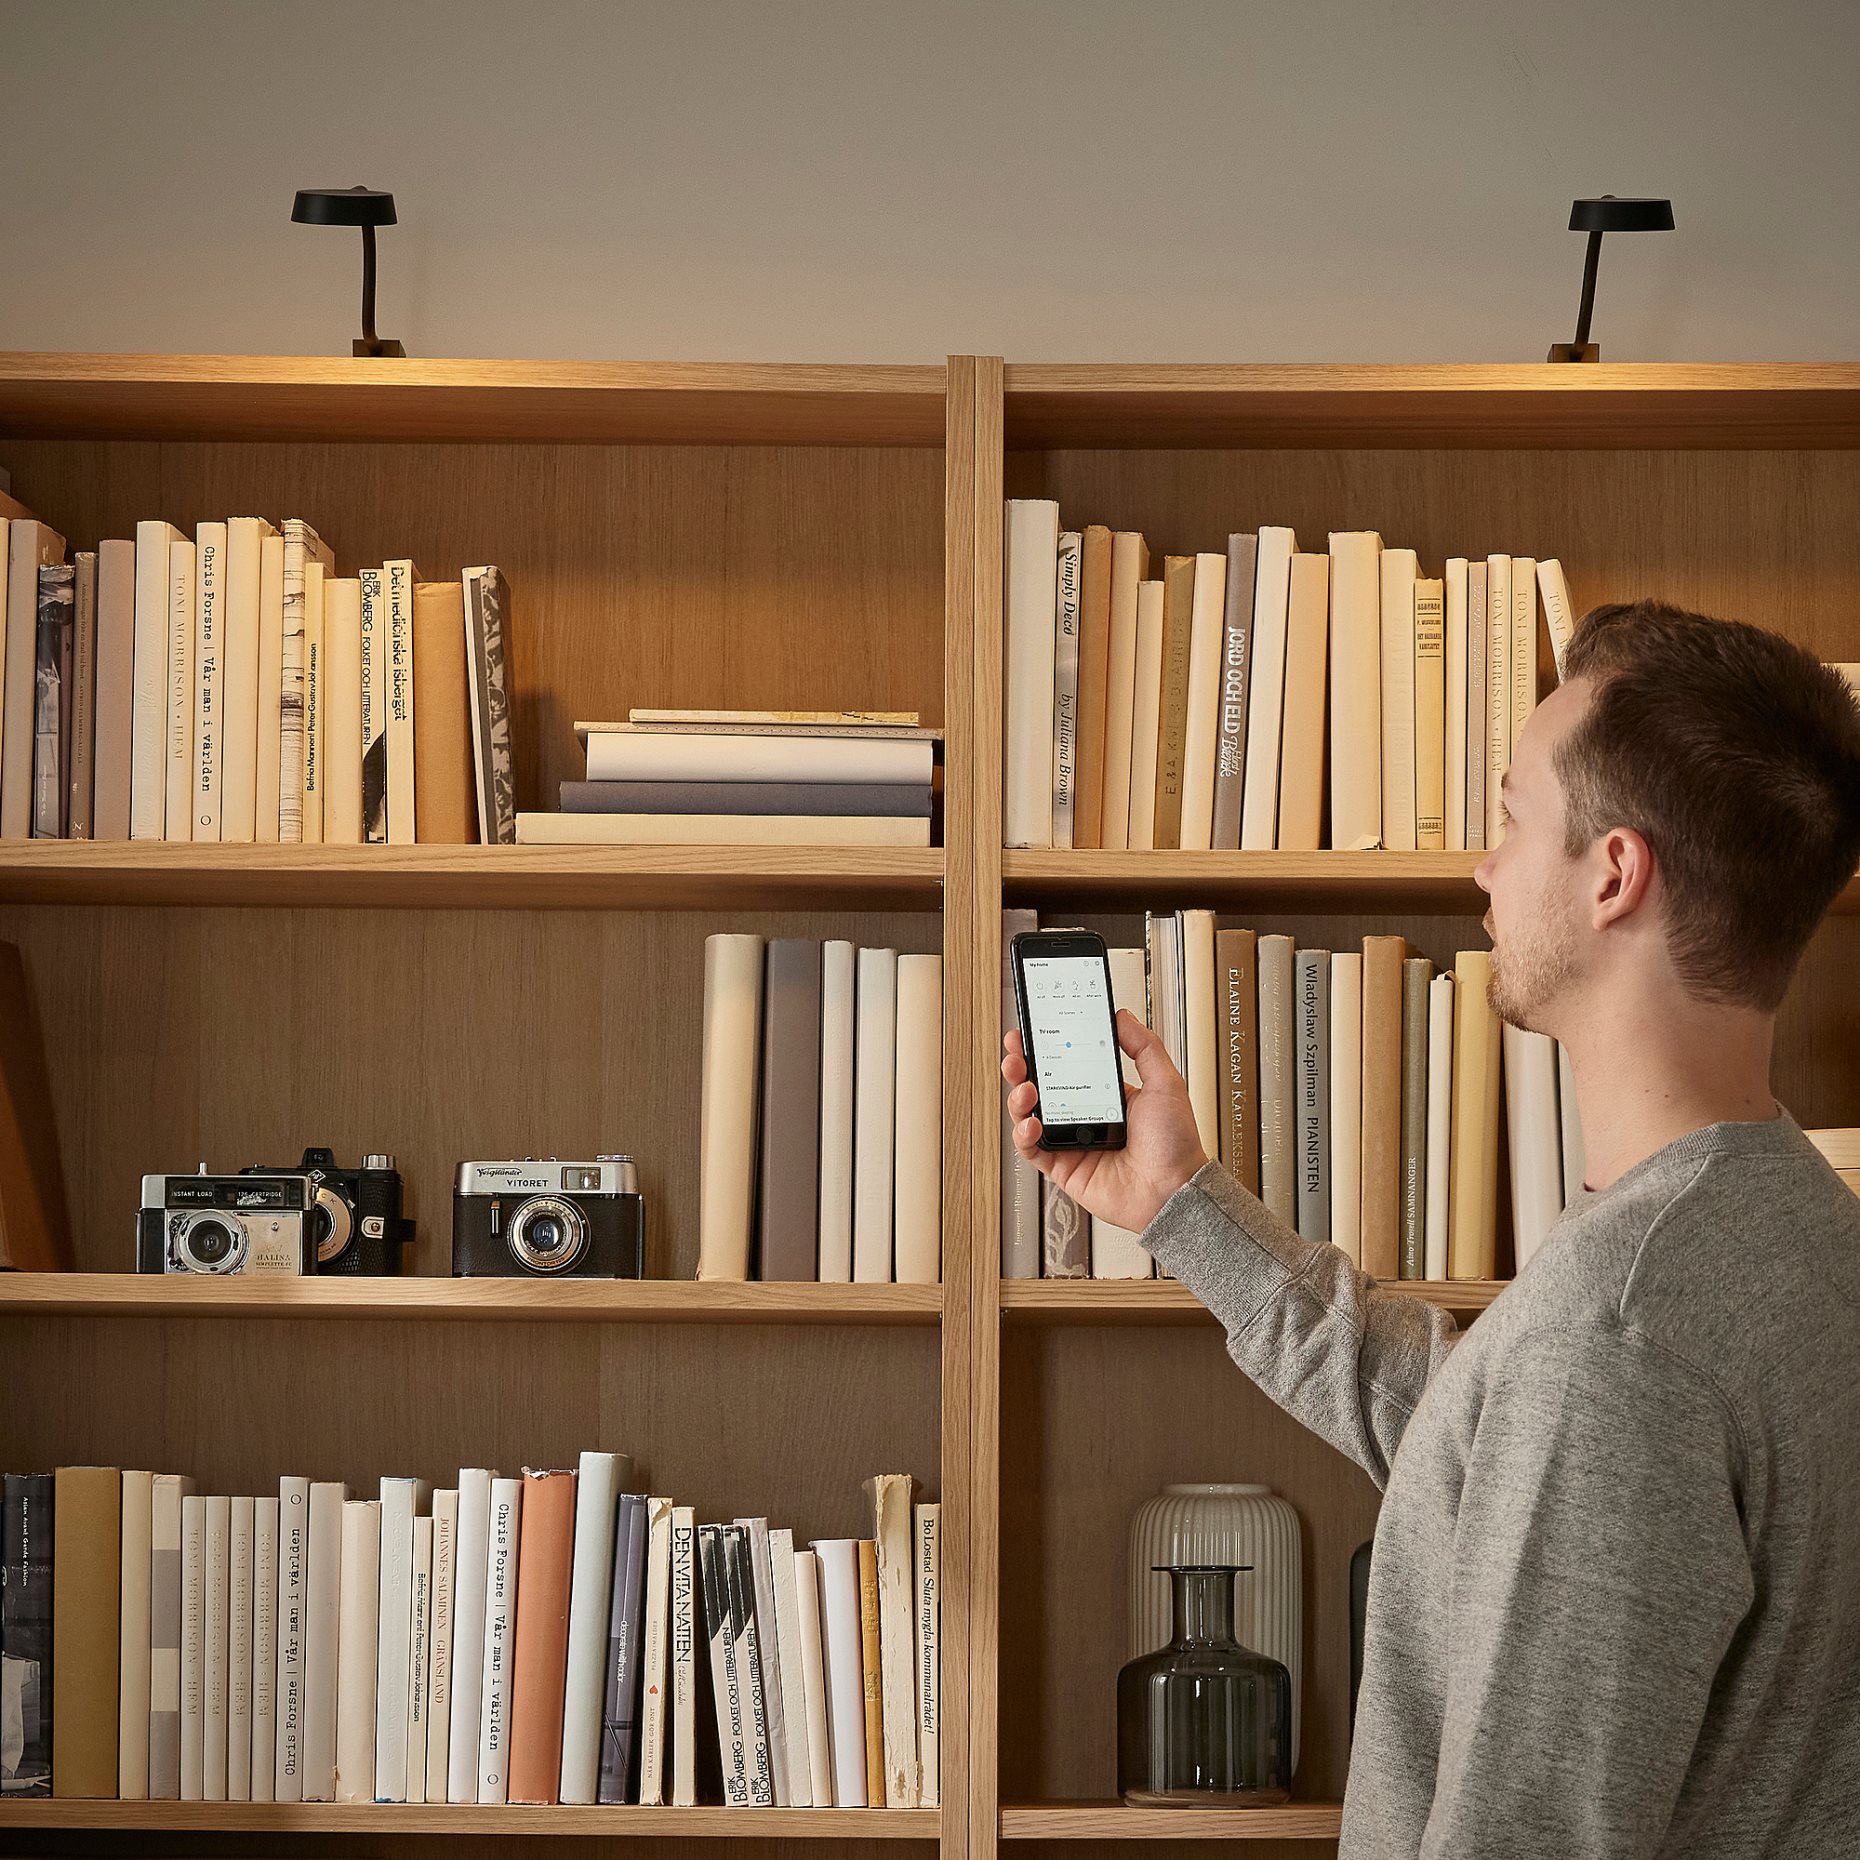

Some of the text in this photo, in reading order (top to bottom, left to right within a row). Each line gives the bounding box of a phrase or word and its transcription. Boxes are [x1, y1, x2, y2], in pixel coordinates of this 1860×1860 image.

[362, 572, 377, 632] BLOMBERG
[372, 580, 381, 598] ERIK
[1062, 552, 1078, 598] Simply
[1549, 592, 1566, 631] TONI
[174, 574, 186, 760] TONI MORRISON HEM
[202, 546, 216, 792] Chris Forsne Vår man i världen
[362, 636, 370, 666] FOLKET
[390, 567, 408, 722] Det medicinska isberget
[1517, 590, 1528, 723] TONI MORRISON
[362, 668, 370, 688] OCH
[1224, 626, 1246, 734] JORD OCH ELD
[1492, 588, 1504, 772] TONI MORRISON HEM
[306, 768, 315, 791] Befria
[1058, 694, 1073, 806] by Juliana Brown
[1228, 967, 1244, 1025] ELAINE
[1230, 1030, 1246, 1084] KAGAN
[1302, 964, 1320, 1193] Wladyslaw Szpilman PIANISTEN
[1408, 1157, 1416, 1218] SAMNANGER
[674, 1528, 692, 1564] DEN
[924, 1518, 934, 1534] Bo
[924, 1536, 935, 1573] Lostad
[288, 1528, 300, 1587] världen
[675, 1565, 691, 1600] VITA
[290, 1607, 299, 1632] man
[434, 1518, 449, 1704] JOHANNES SALMINEN GRÄNSLAND
[924, 1576, 935, 1605] Sluta
[188, 1530, 200, 1715] TONI MORRISON HEM
[236, 1530, 247, 1716] TONI MORRISON HEM
[258, 1531, 271, 1716] TONI MORRISON HEM
[285, 1638, 298, 1664] Vår
[490, 1503, 510, 1750] Chris Forsne Vår man i världen
[617, 1620, 630, 1684] decorate with color
[676, 1601, 691, 1662] NATTEN
[286, 1680, 298, 1730] Forsne
[722, 1626, 748, 1802] BLOMBERG FOLKET OCH LITTERATUREN
[746, 1628, 771, 1803] BLOMBERG FOLKET OCH LITTERATUREN
[924, 1644, 936, 1734] kommunalrådet!
[284, 1734, 296, 1776] Chris
[727, 1776, 736, 1794] ERIK
[750, 1777, 760, 1794] ERIK
